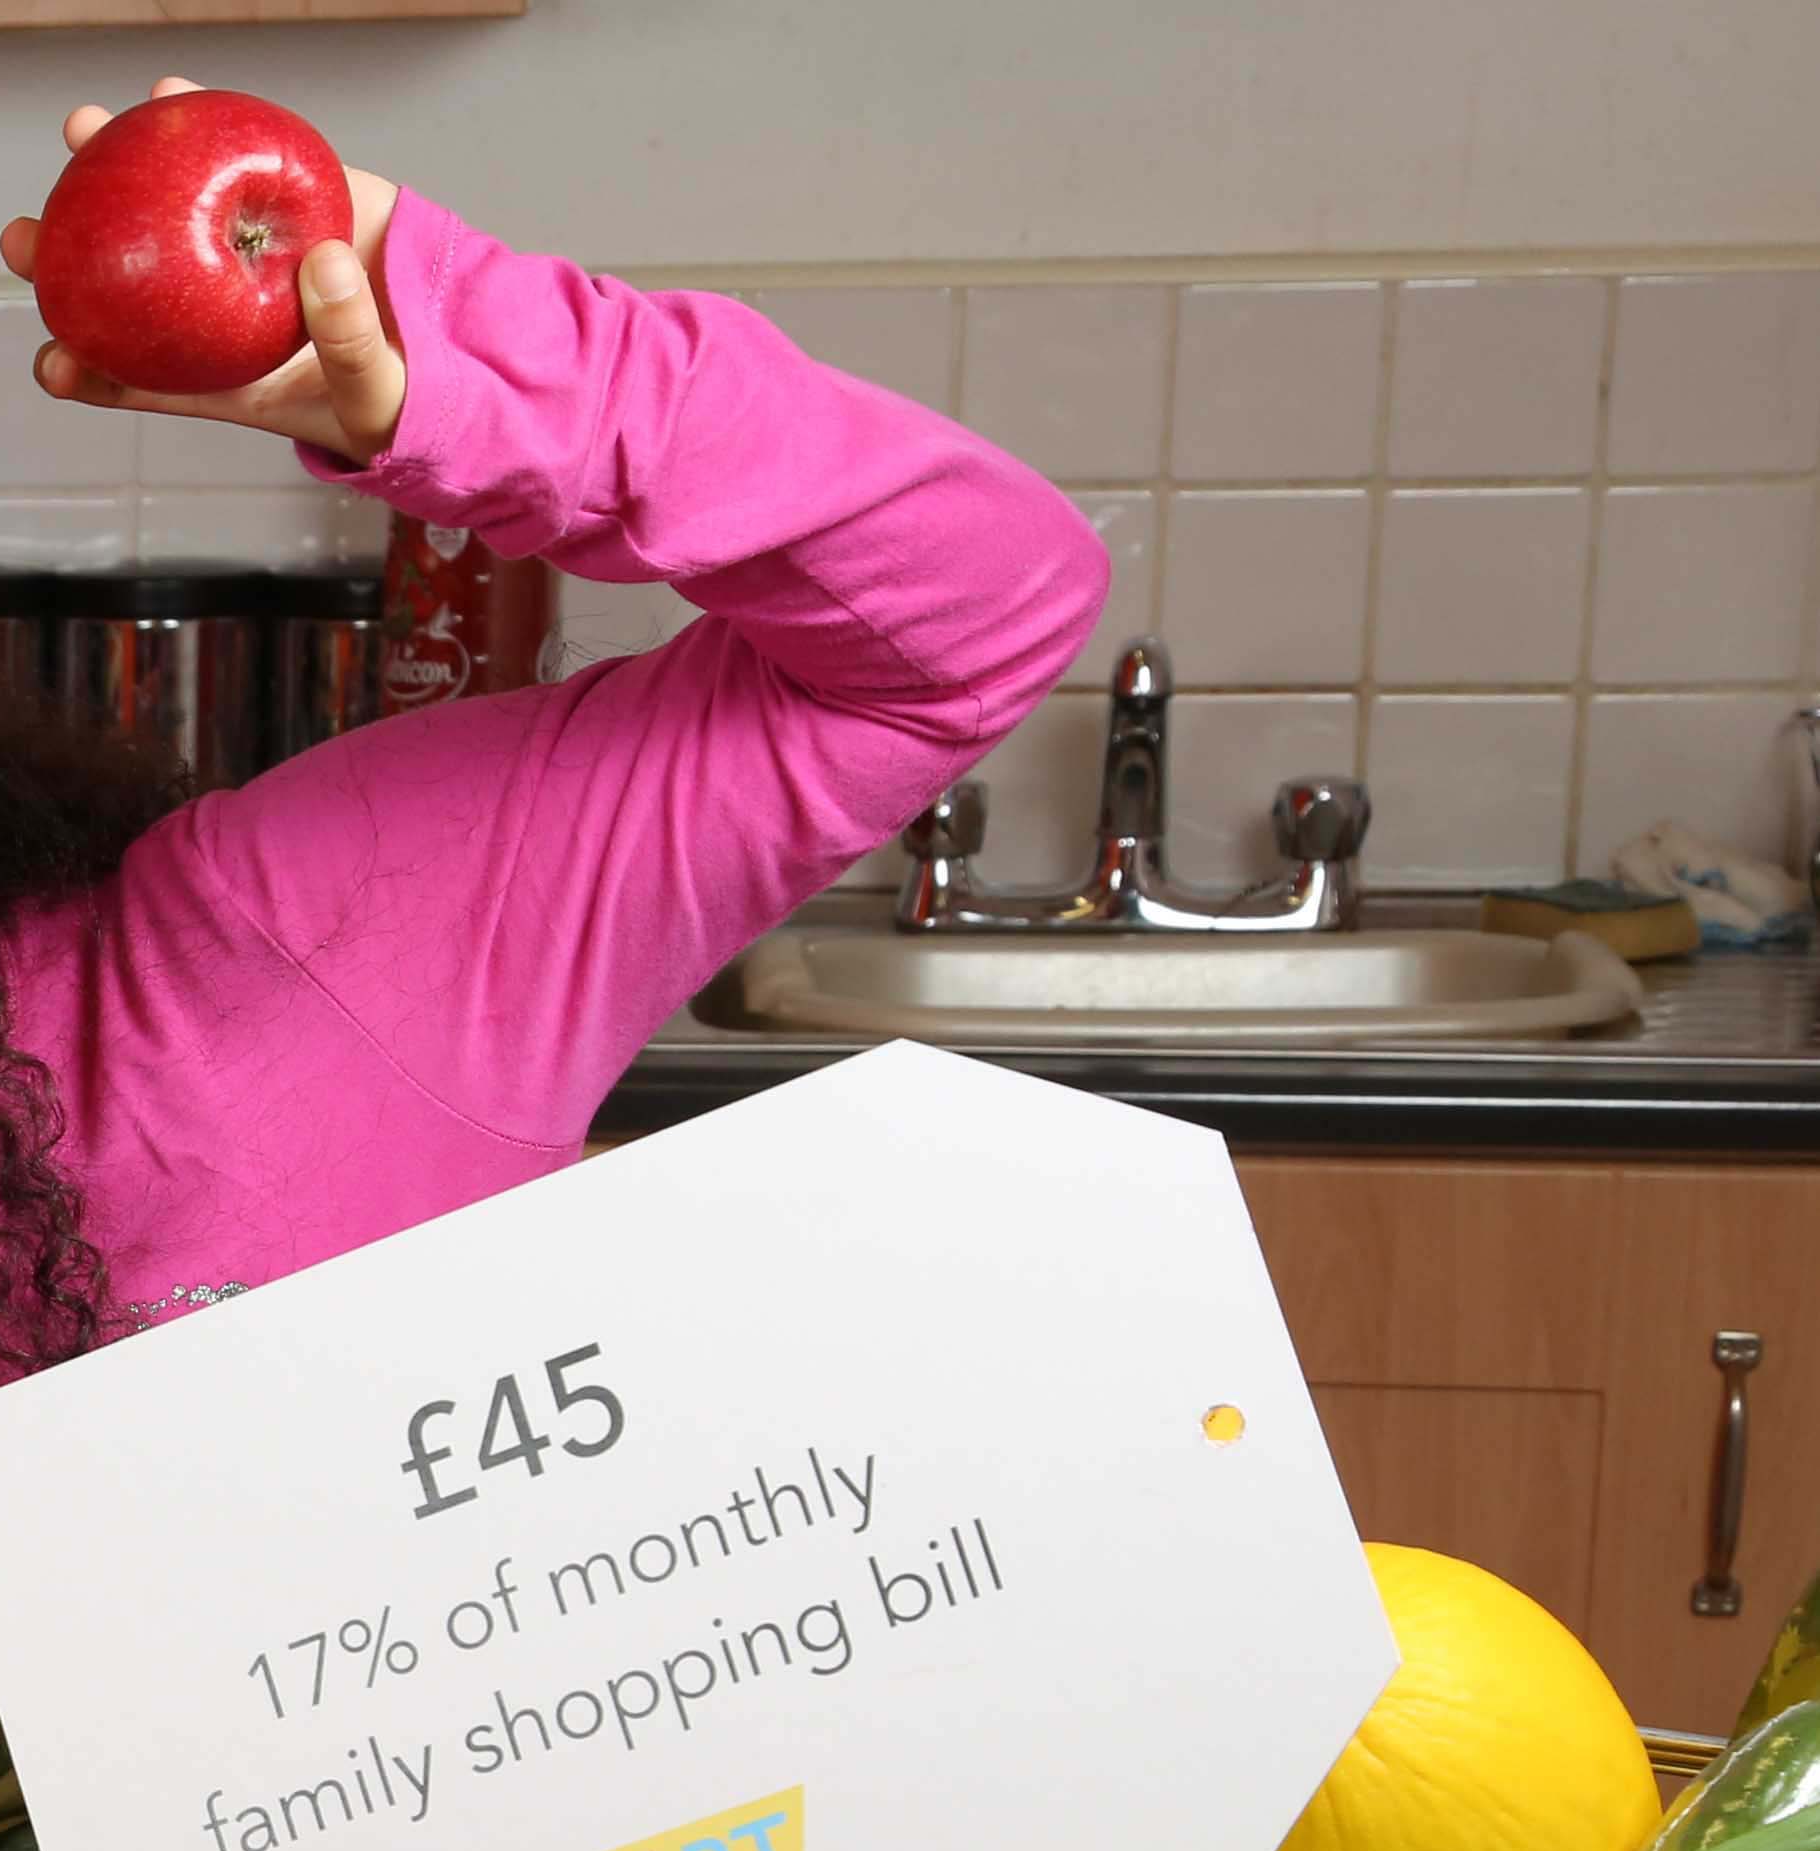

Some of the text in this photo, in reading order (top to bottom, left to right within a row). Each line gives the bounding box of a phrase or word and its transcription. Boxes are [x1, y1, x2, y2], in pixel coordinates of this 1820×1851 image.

[400, 1342, 628, 1521] £45
[247, 1446, 880, 1720] 17% of monthly
[464, 1597, 856, 1778] shopping
[881, 1517, 1006, 1630] bill
